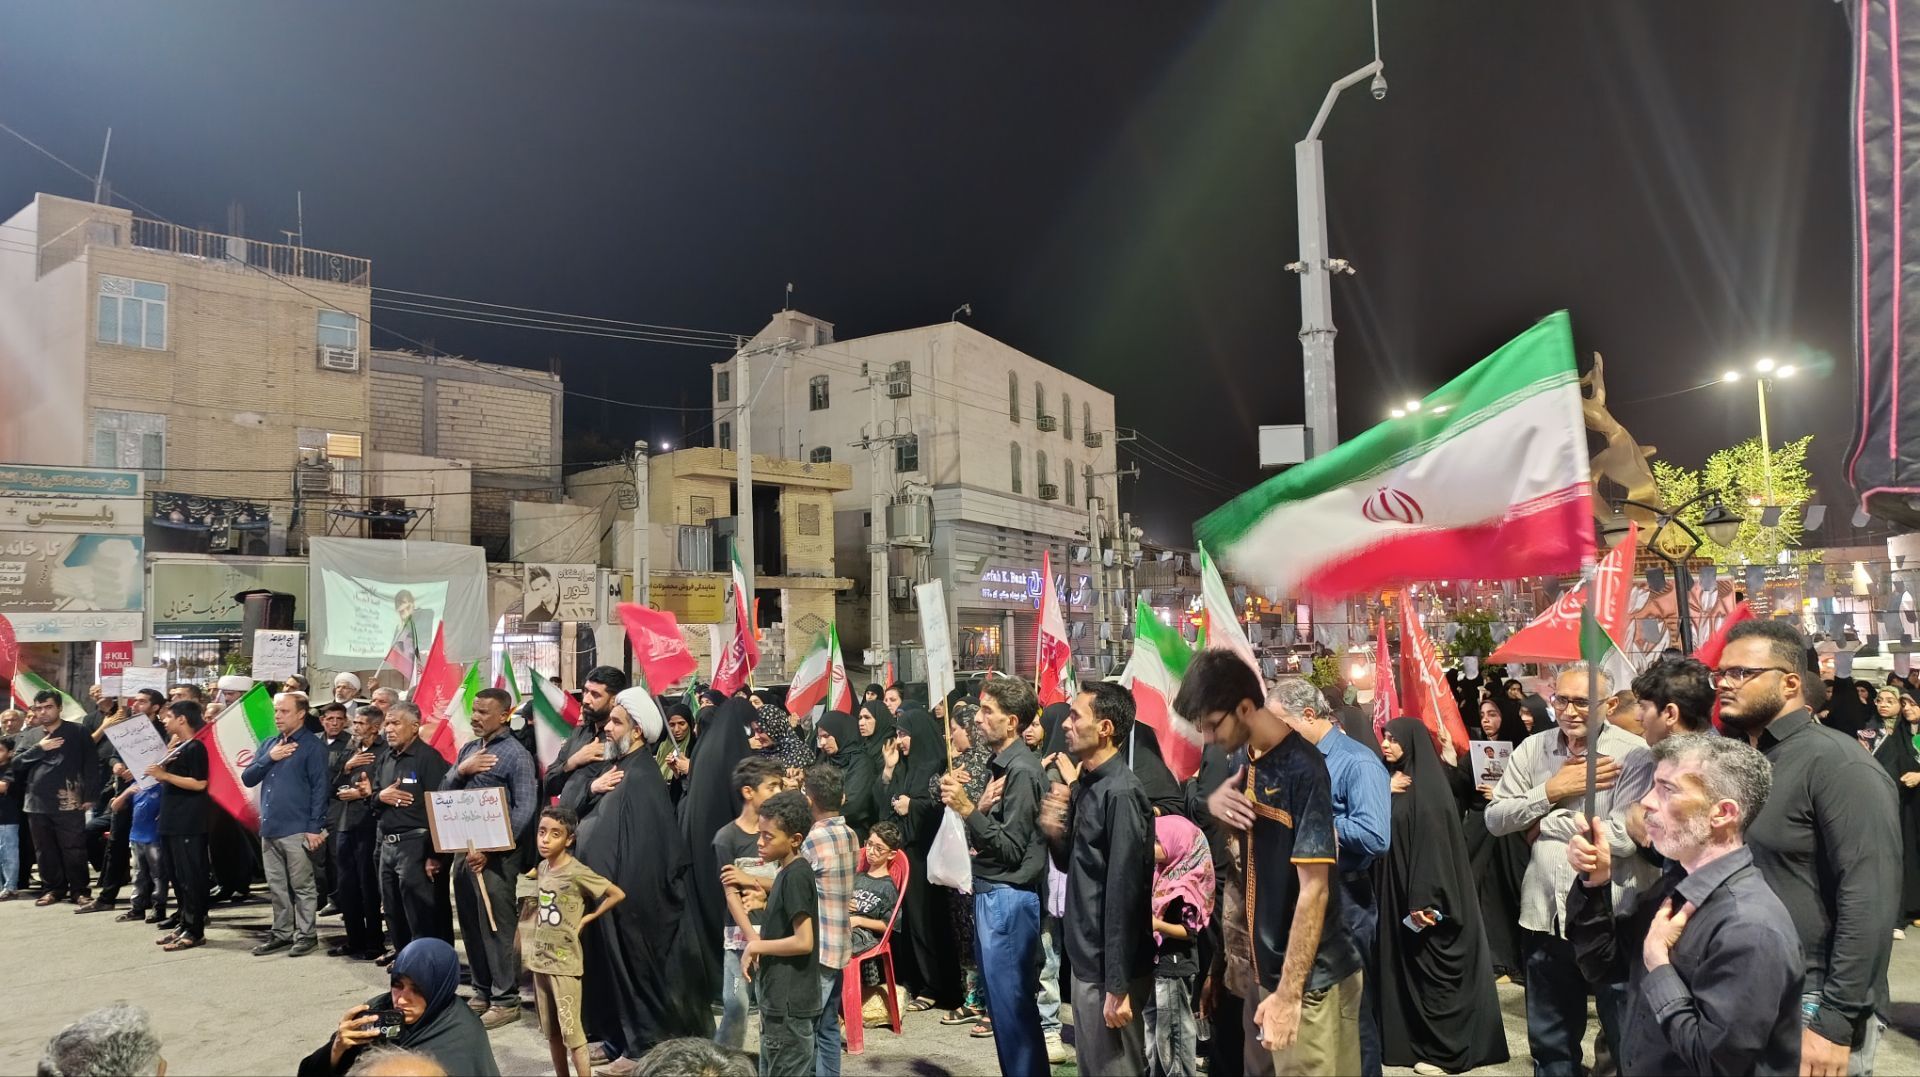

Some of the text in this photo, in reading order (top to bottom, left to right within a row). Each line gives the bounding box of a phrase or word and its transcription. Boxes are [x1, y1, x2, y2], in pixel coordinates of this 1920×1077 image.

[26, 504, 115, 528] پلیس
[1010, 571, 1027, 585] Bank
[563, 583, 590, 600] نور
